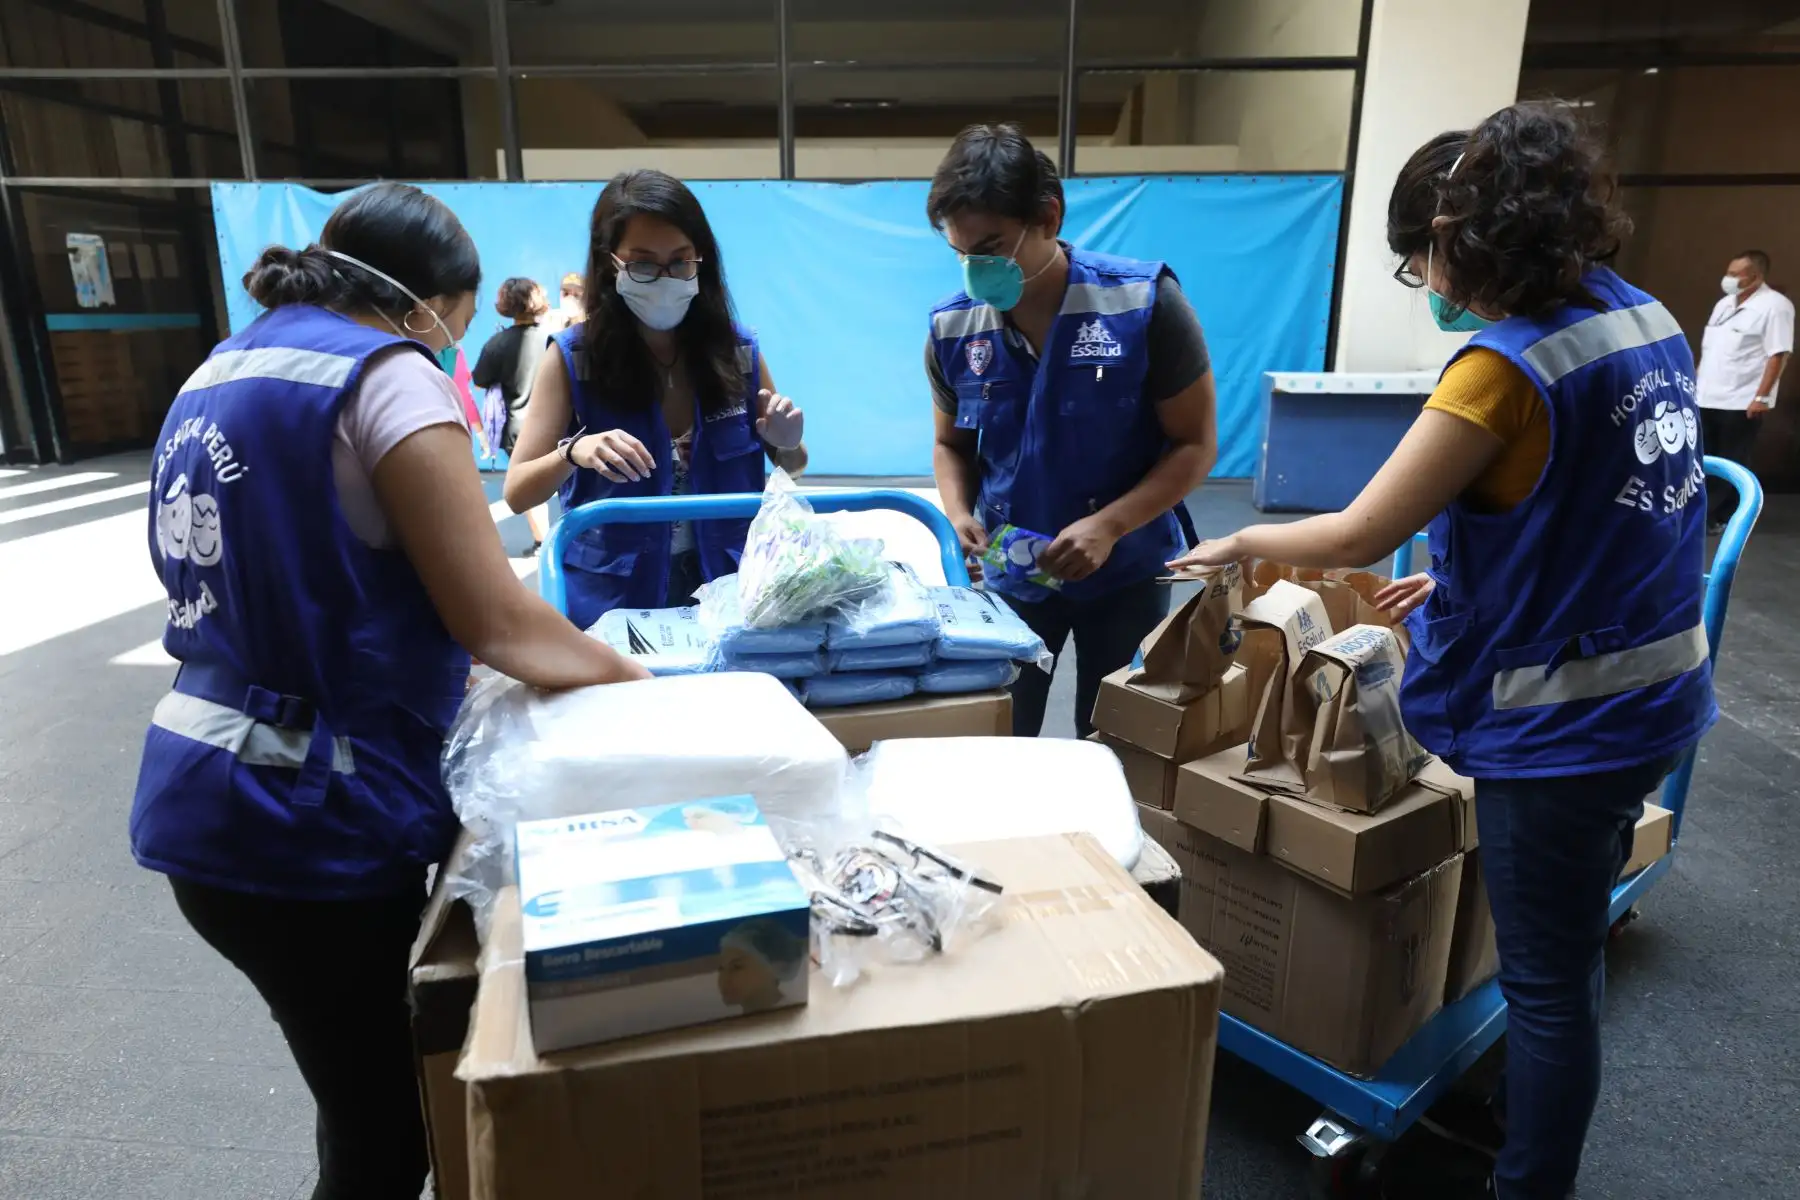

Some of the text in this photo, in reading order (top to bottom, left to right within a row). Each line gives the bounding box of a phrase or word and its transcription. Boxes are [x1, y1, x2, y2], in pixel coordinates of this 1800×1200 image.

[1070, 343, 1122, 358] EsSalud
[1610, 368, 1671, 427] HOSPITAL
[201, 422, 250, 484] PERÚ
